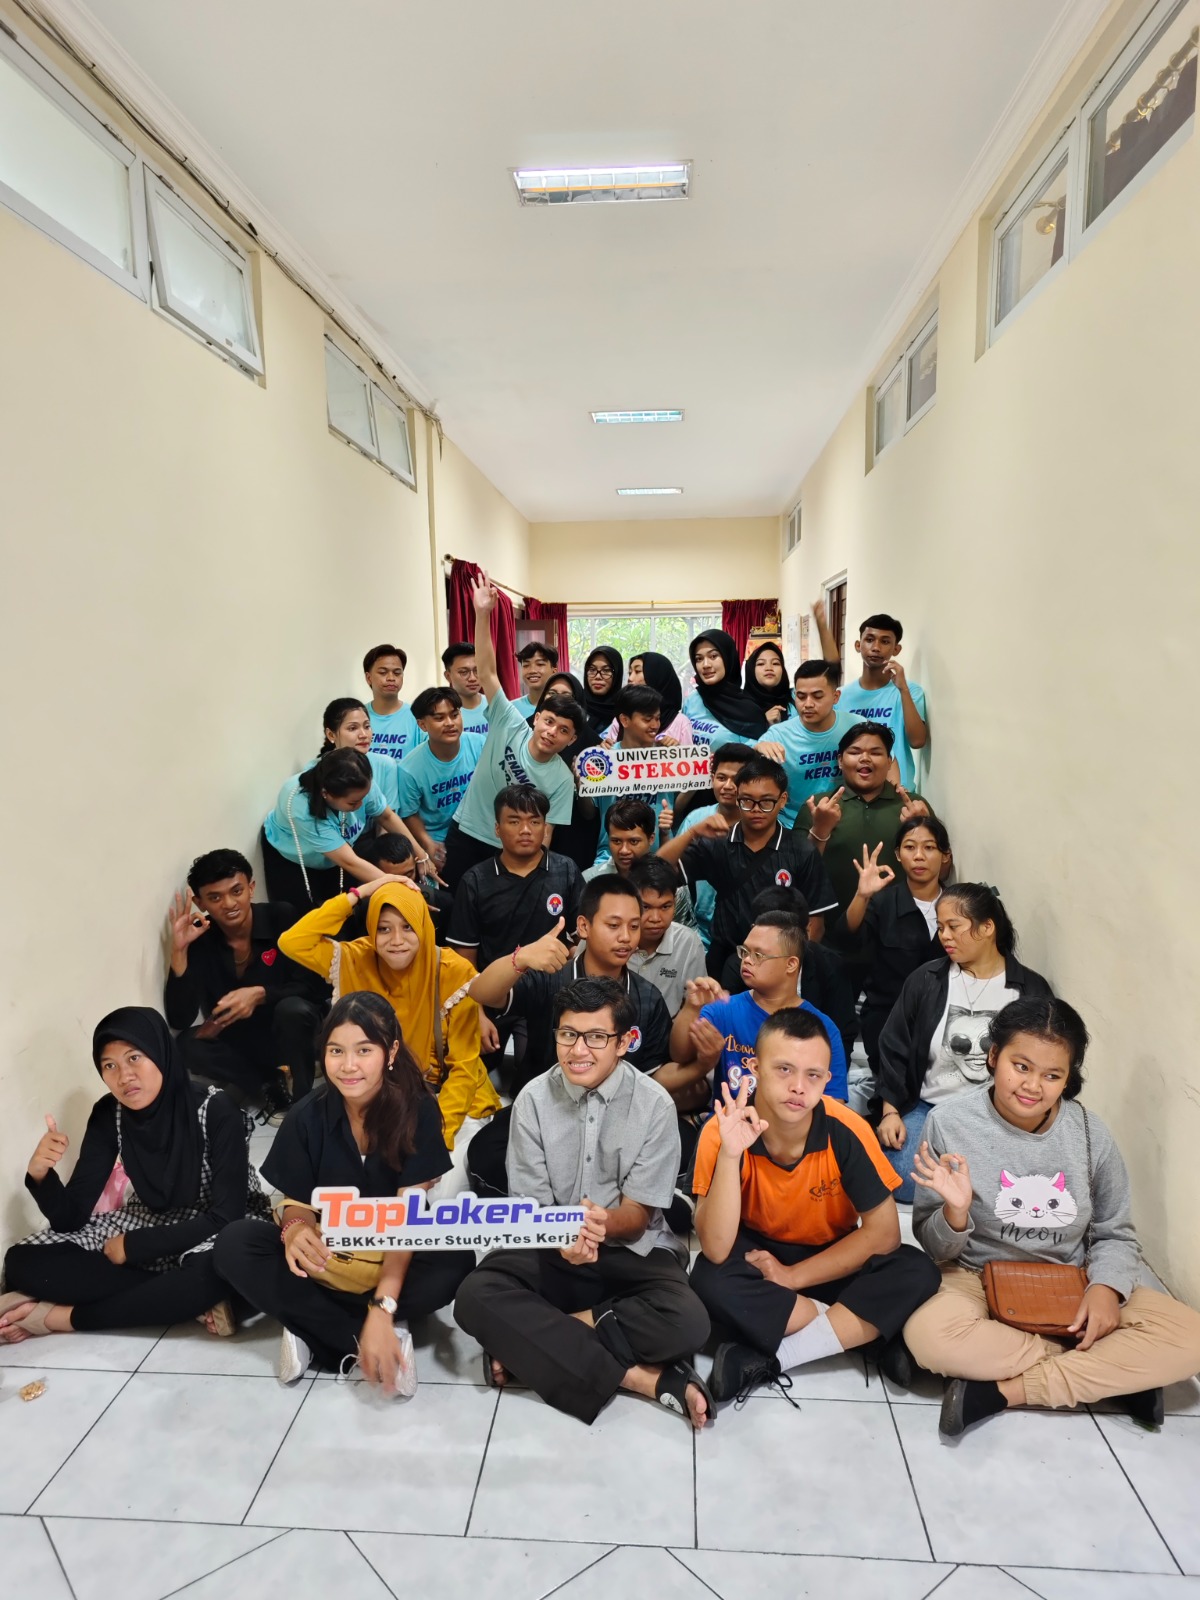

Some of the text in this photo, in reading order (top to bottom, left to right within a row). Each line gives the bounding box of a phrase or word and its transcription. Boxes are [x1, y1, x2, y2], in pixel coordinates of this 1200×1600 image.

[690, 718, 720, 734] NANG
[371, 733, 407, 745] NANG
[616, 746, 709, 762] UNIVERSITAS
[798, 749, 839, 766] SENAN
[617, 760, 709, 780] STEKOM
[804, 765, 843, 780] KERJ
[581, 785, 630, 795] Kuliahnya
[632, 780, 706, 792] Menyenangkan
[437, 790, 466, 809] KER
[319, 1193, 584, 1234] TopLoker.com
[325, 1232, 579, 1248] E-BKK+Tracer Study+Tes Kerja
